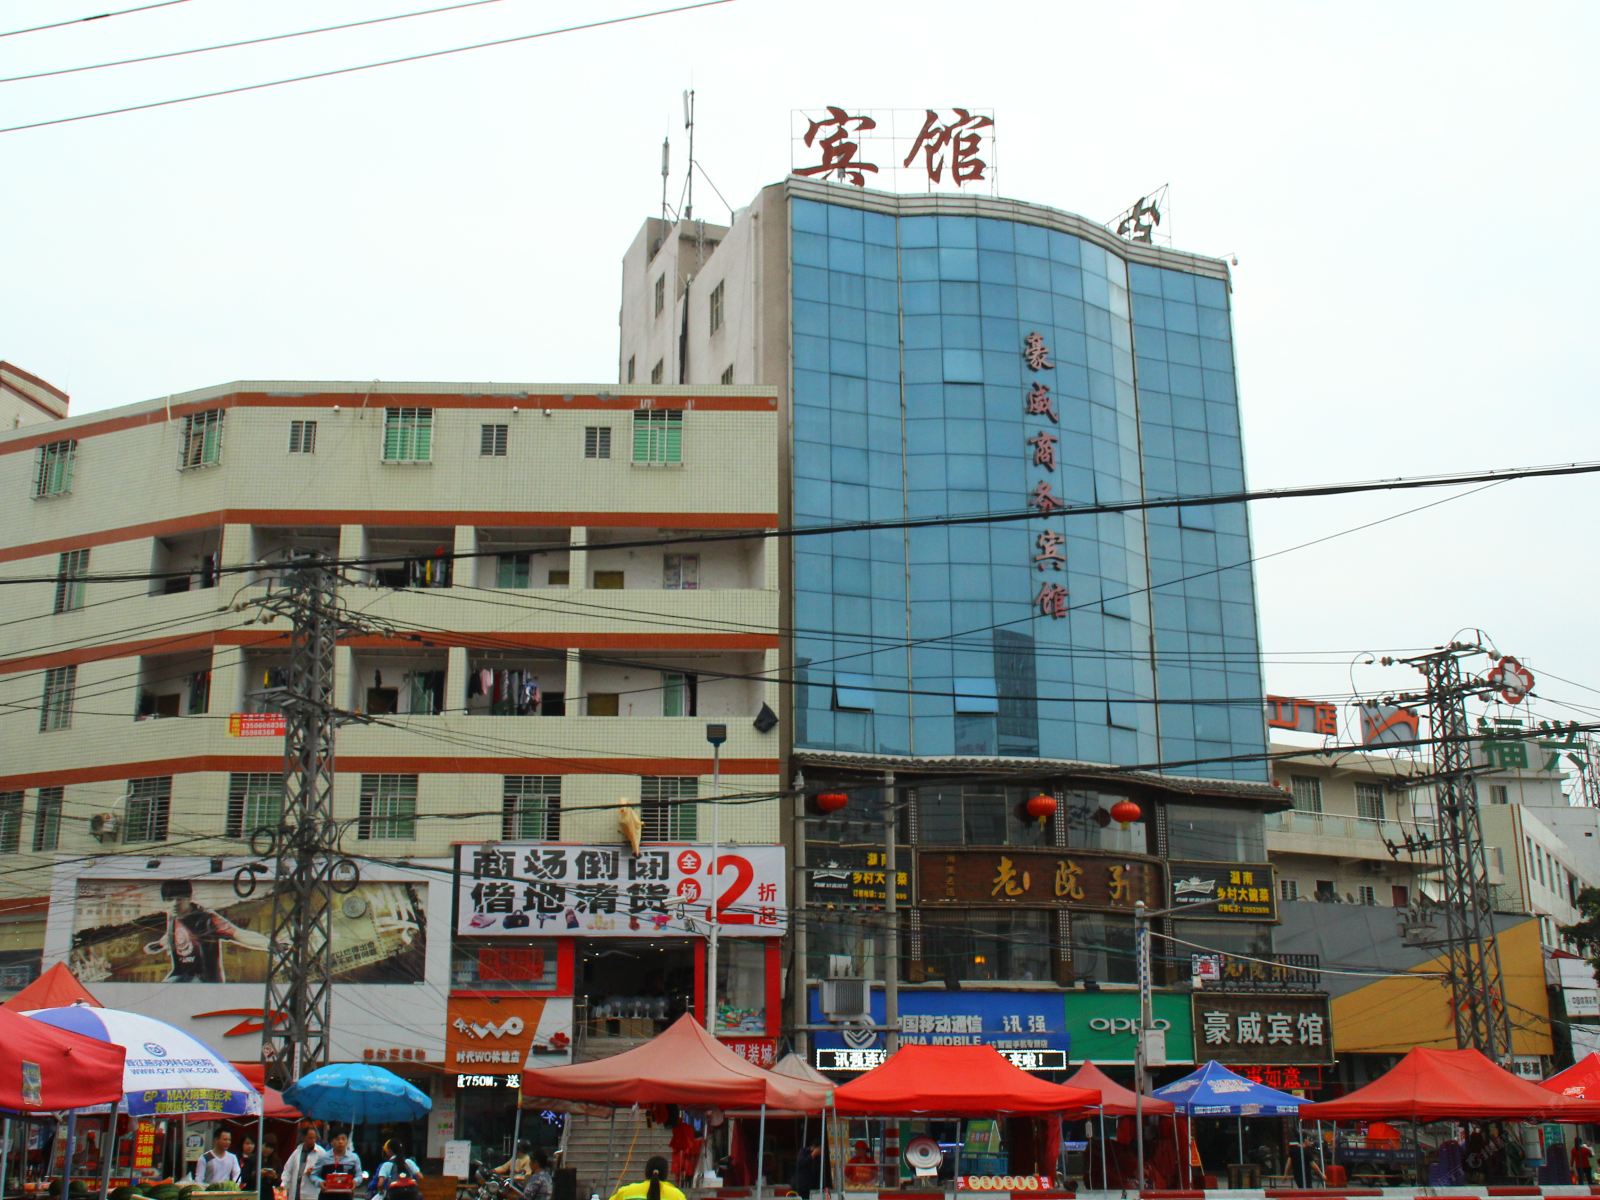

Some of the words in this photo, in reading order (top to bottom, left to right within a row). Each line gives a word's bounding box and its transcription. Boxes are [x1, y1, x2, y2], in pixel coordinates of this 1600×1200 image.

[793, 106, 993, 187] 宾馆
[1021, 332, 1070, 619] 豪威商务宾馆
[473, 849, 670, 881] 商场倒闭
[853, 871, 908, 886] 乡村大菜
[1230, 871, 1253, 886] 湖南
[471, 882, 671, 915] 借地清货
[705, 854, 755, 925] 2
[758, 883, 777, 925] 折起
[1217, 887, 1270, 902] 乡村大碗菜
[1003, 1016, 1047, 1033] 讯强
[1203, 1010, 1324, 1046] 豪威宾馆
[897, 1036, 928, 1047] HINA
[932, 1035, 981, 1047] MOBILE
